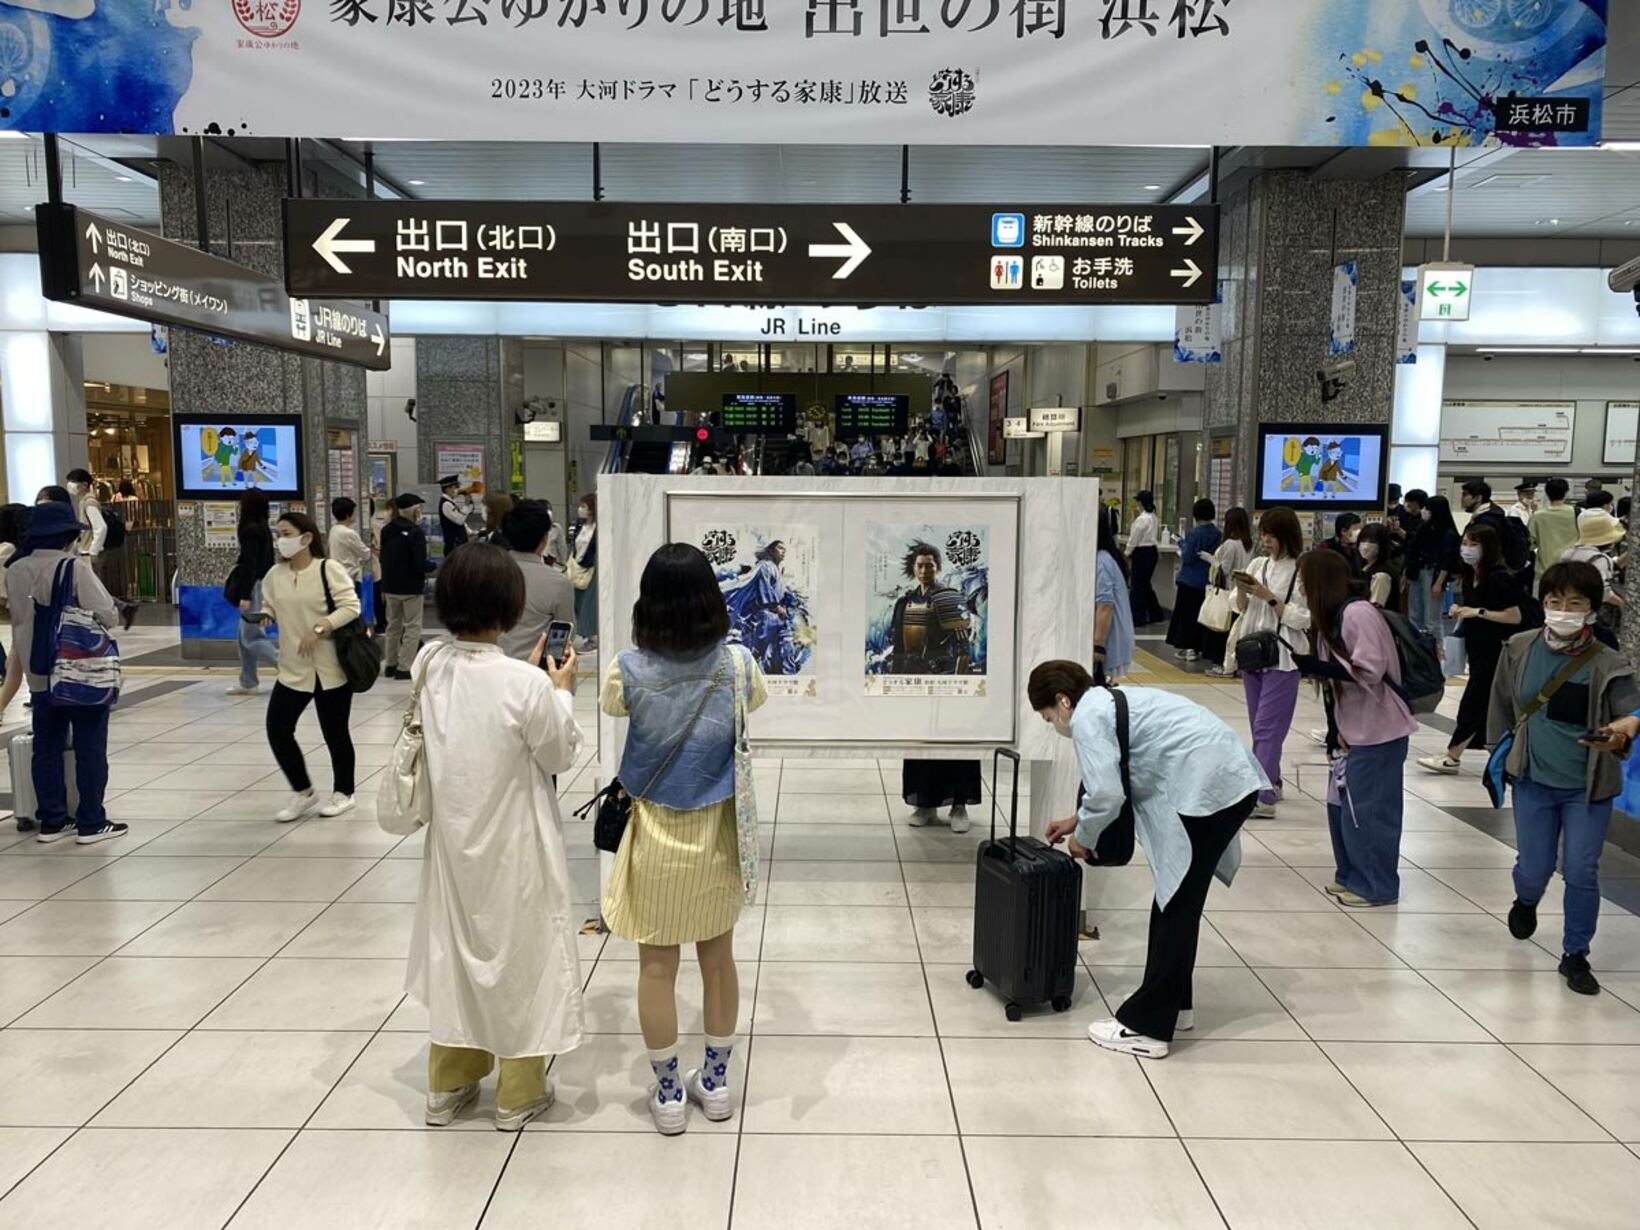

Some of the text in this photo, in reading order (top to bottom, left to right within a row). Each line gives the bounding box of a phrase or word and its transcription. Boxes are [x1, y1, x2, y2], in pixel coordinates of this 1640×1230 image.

[491, 78, 566, 100] 2023年
[1508, 103, 1577, 125] 浜松市
[1032, 213, 1153, 234] 新幹線のりば
[396, 218, 556, 252] 出口（北口）
[627, 220, 788, 255] 出口（南口）
[1032, 234, 1164, 247] Shinkansen Tracks
[107, 245, 144, 267] North Exit
[1072, 256, 1134, 276] お手洗
[396, 256, 528, 279] North Exit
[628, 258, 763, 282] South Exit
[1072, 276, 1118, 289] Toilets
[130, 291, 153, 307] Shops
[314, 305, 367, 338] JR線のりば
[761, 318, 841, 335] JR Line
[315, 328, 342, 349] JR Line
